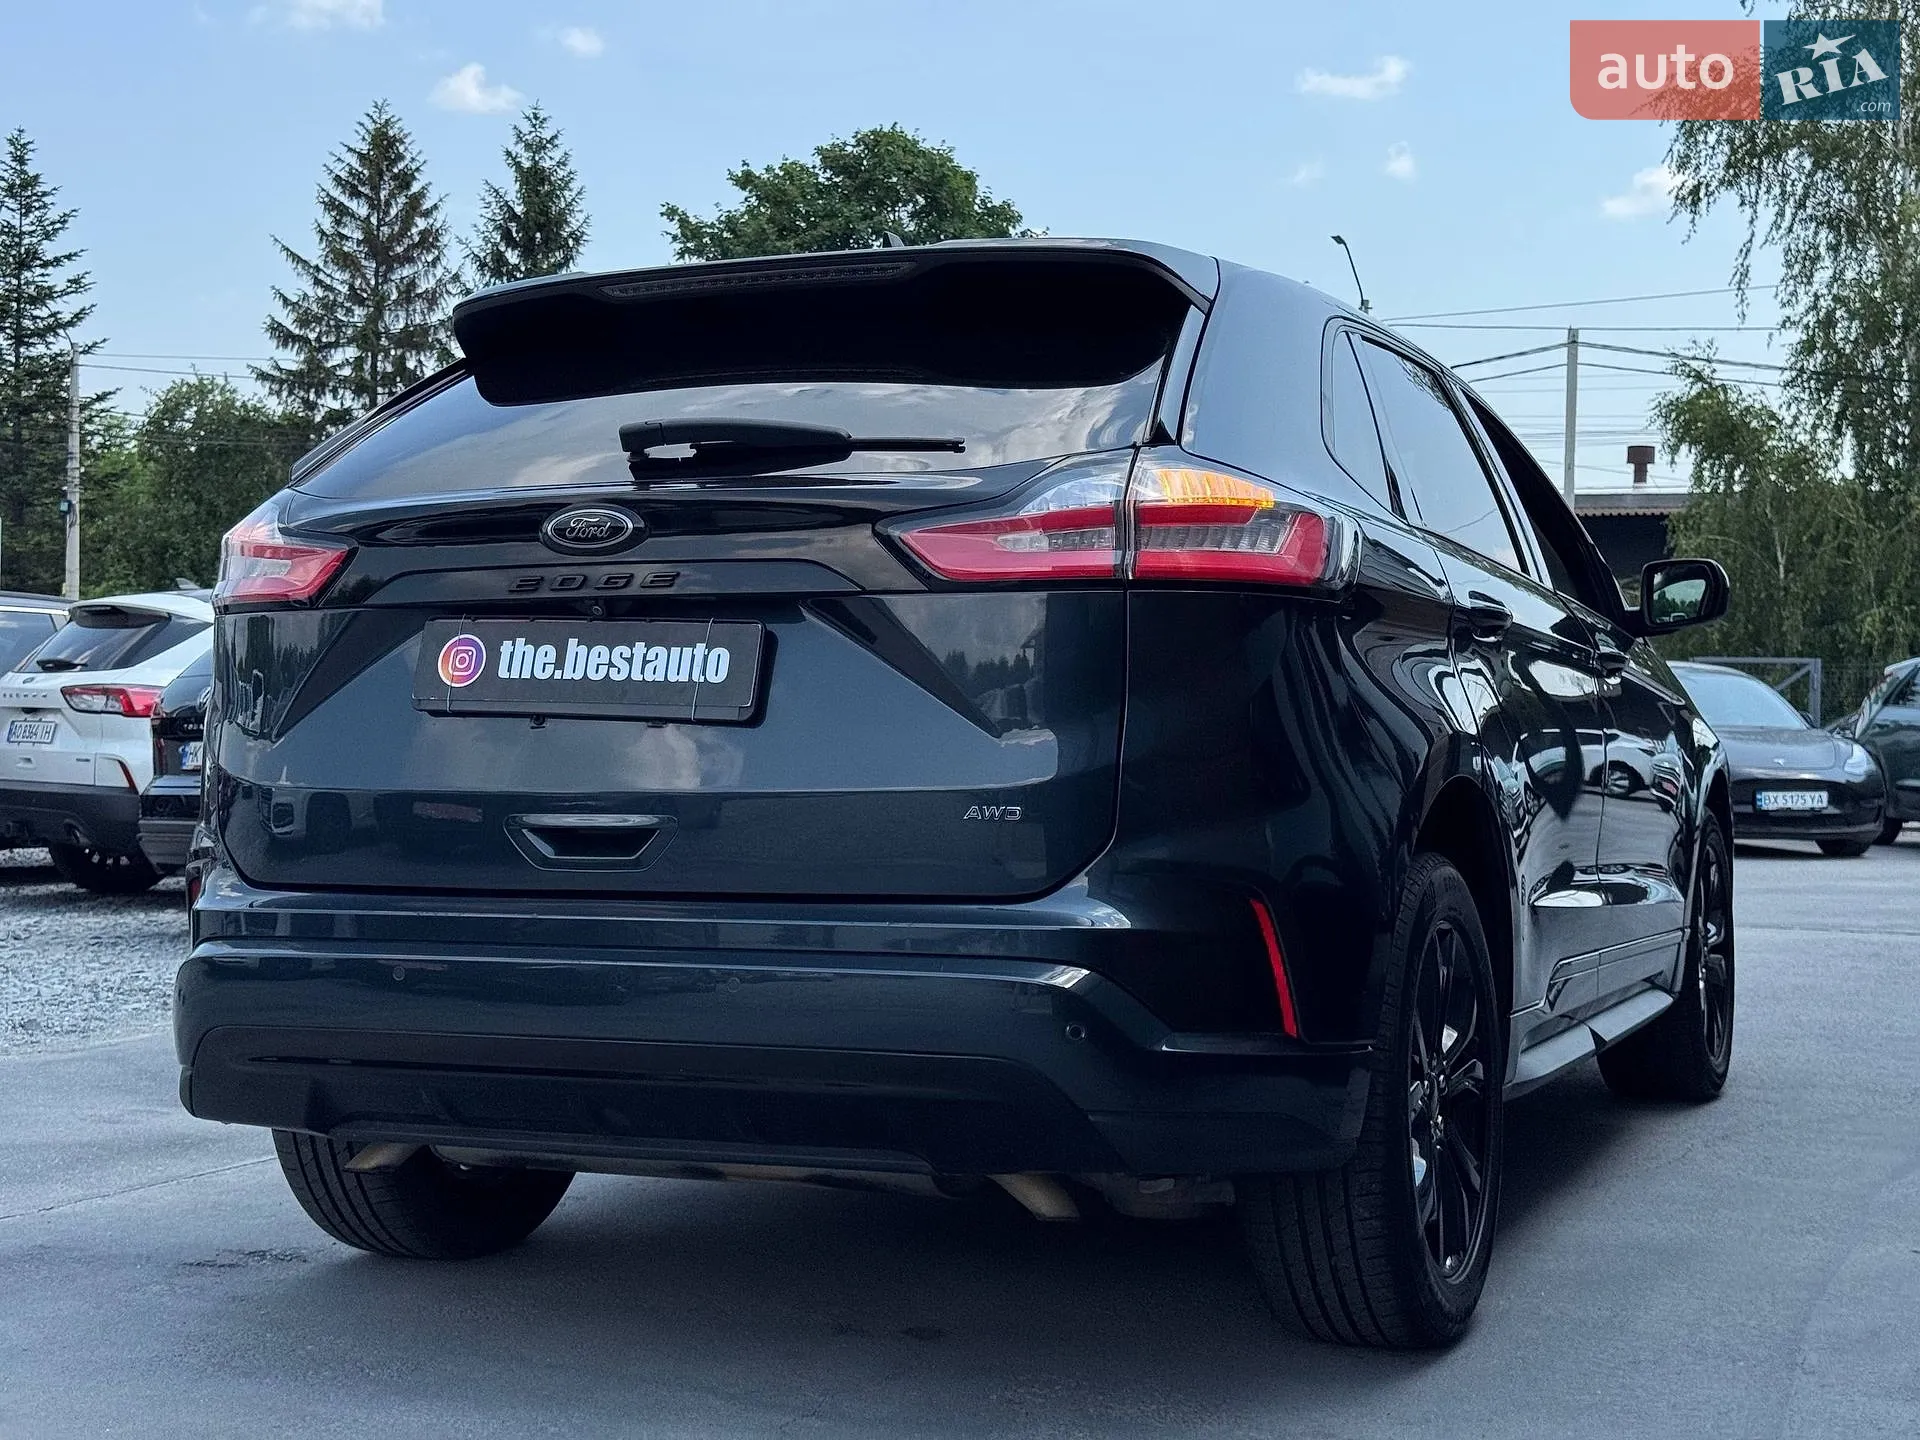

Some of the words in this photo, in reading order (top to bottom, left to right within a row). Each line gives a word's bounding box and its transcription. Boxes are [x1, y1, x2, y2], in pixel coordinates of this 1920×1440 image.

[565, 517, 611, 538] Ford
[509, 571, 680, 592] EDGE
[498, 637, 730, 684] the.bestauto
[963, 805, 1022, 821] AWD
